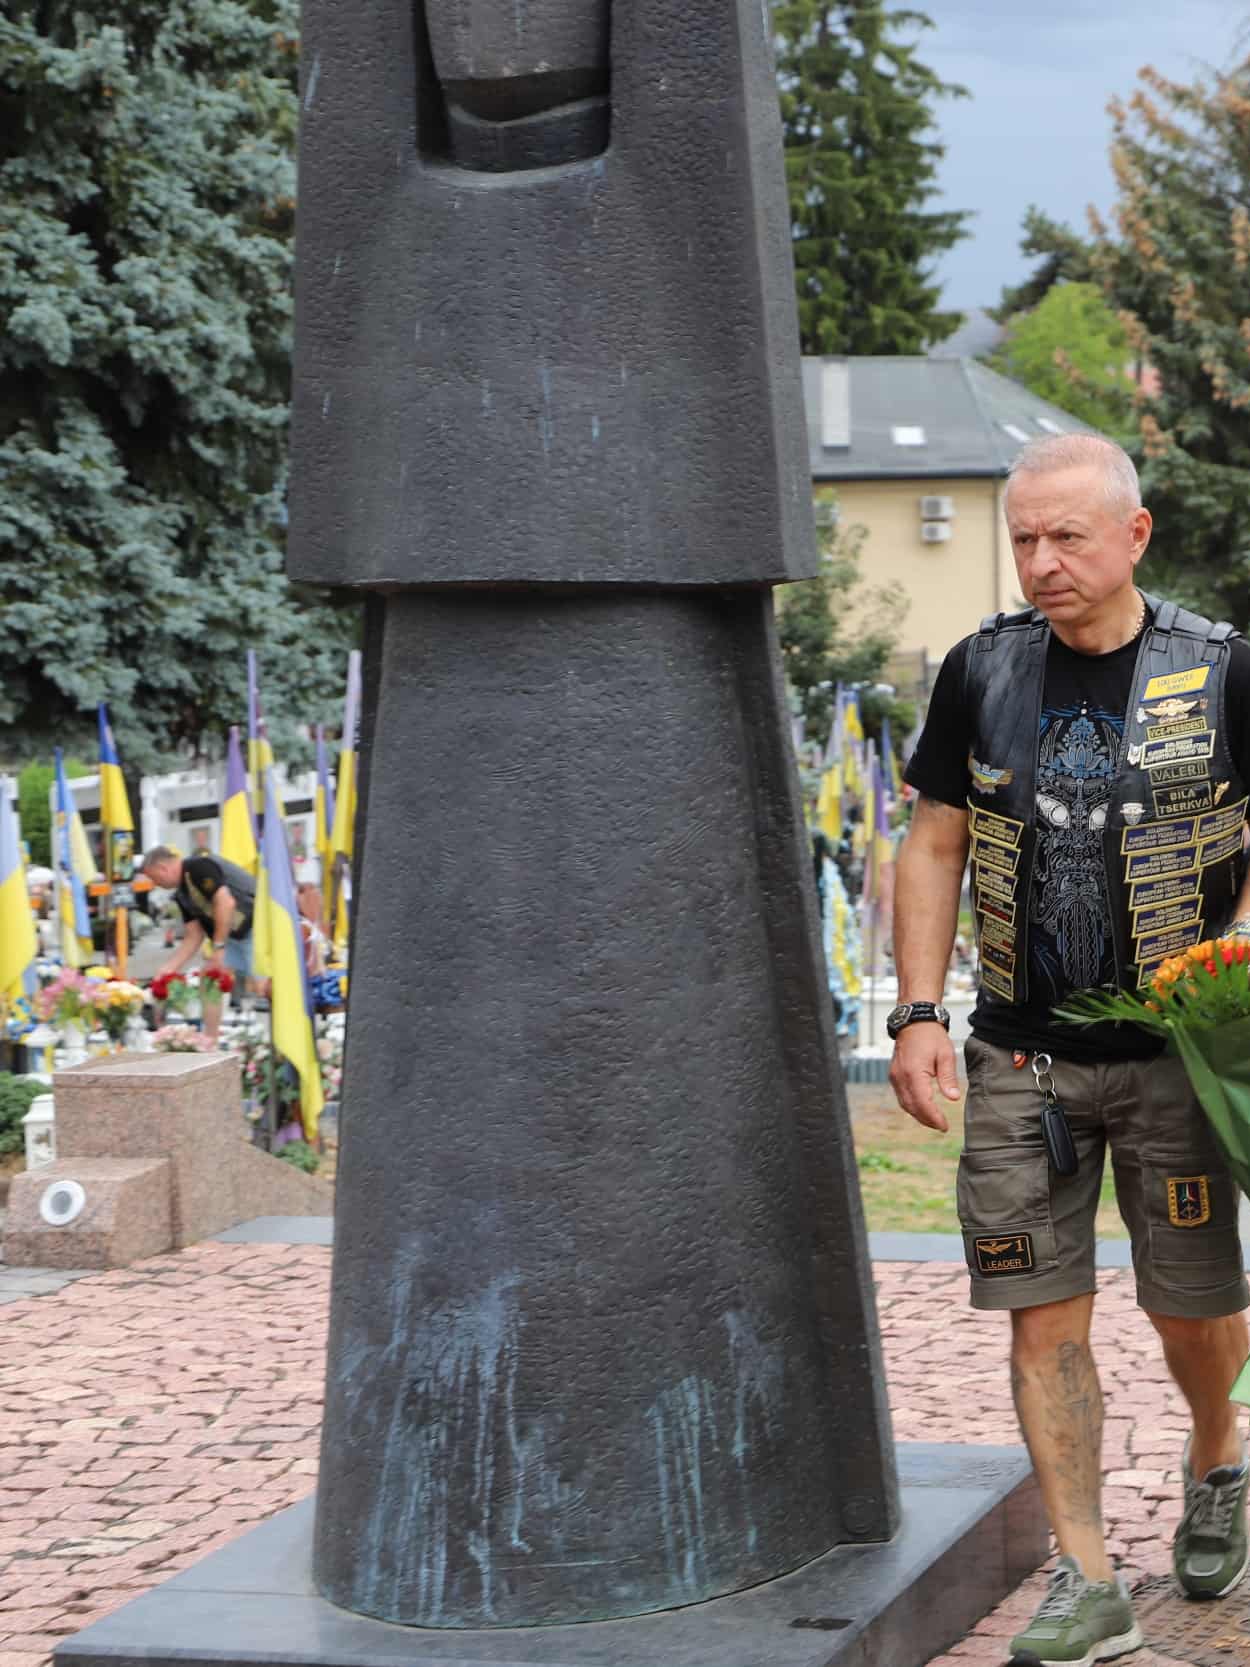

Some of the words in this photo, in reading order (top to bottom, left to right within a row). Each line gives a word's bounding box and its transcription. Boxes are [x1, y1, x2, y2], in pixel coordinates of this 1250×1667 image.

[1151, 719, 1204, 738] VICE-PRESIDENT
[1169, 788, 1196, 802] BILA
[1159, 797, 1210, 815] TSERKVA
[1016, 1239, 1024, 1252] 1
[987, 1258, 1023, 1269] LEADER
